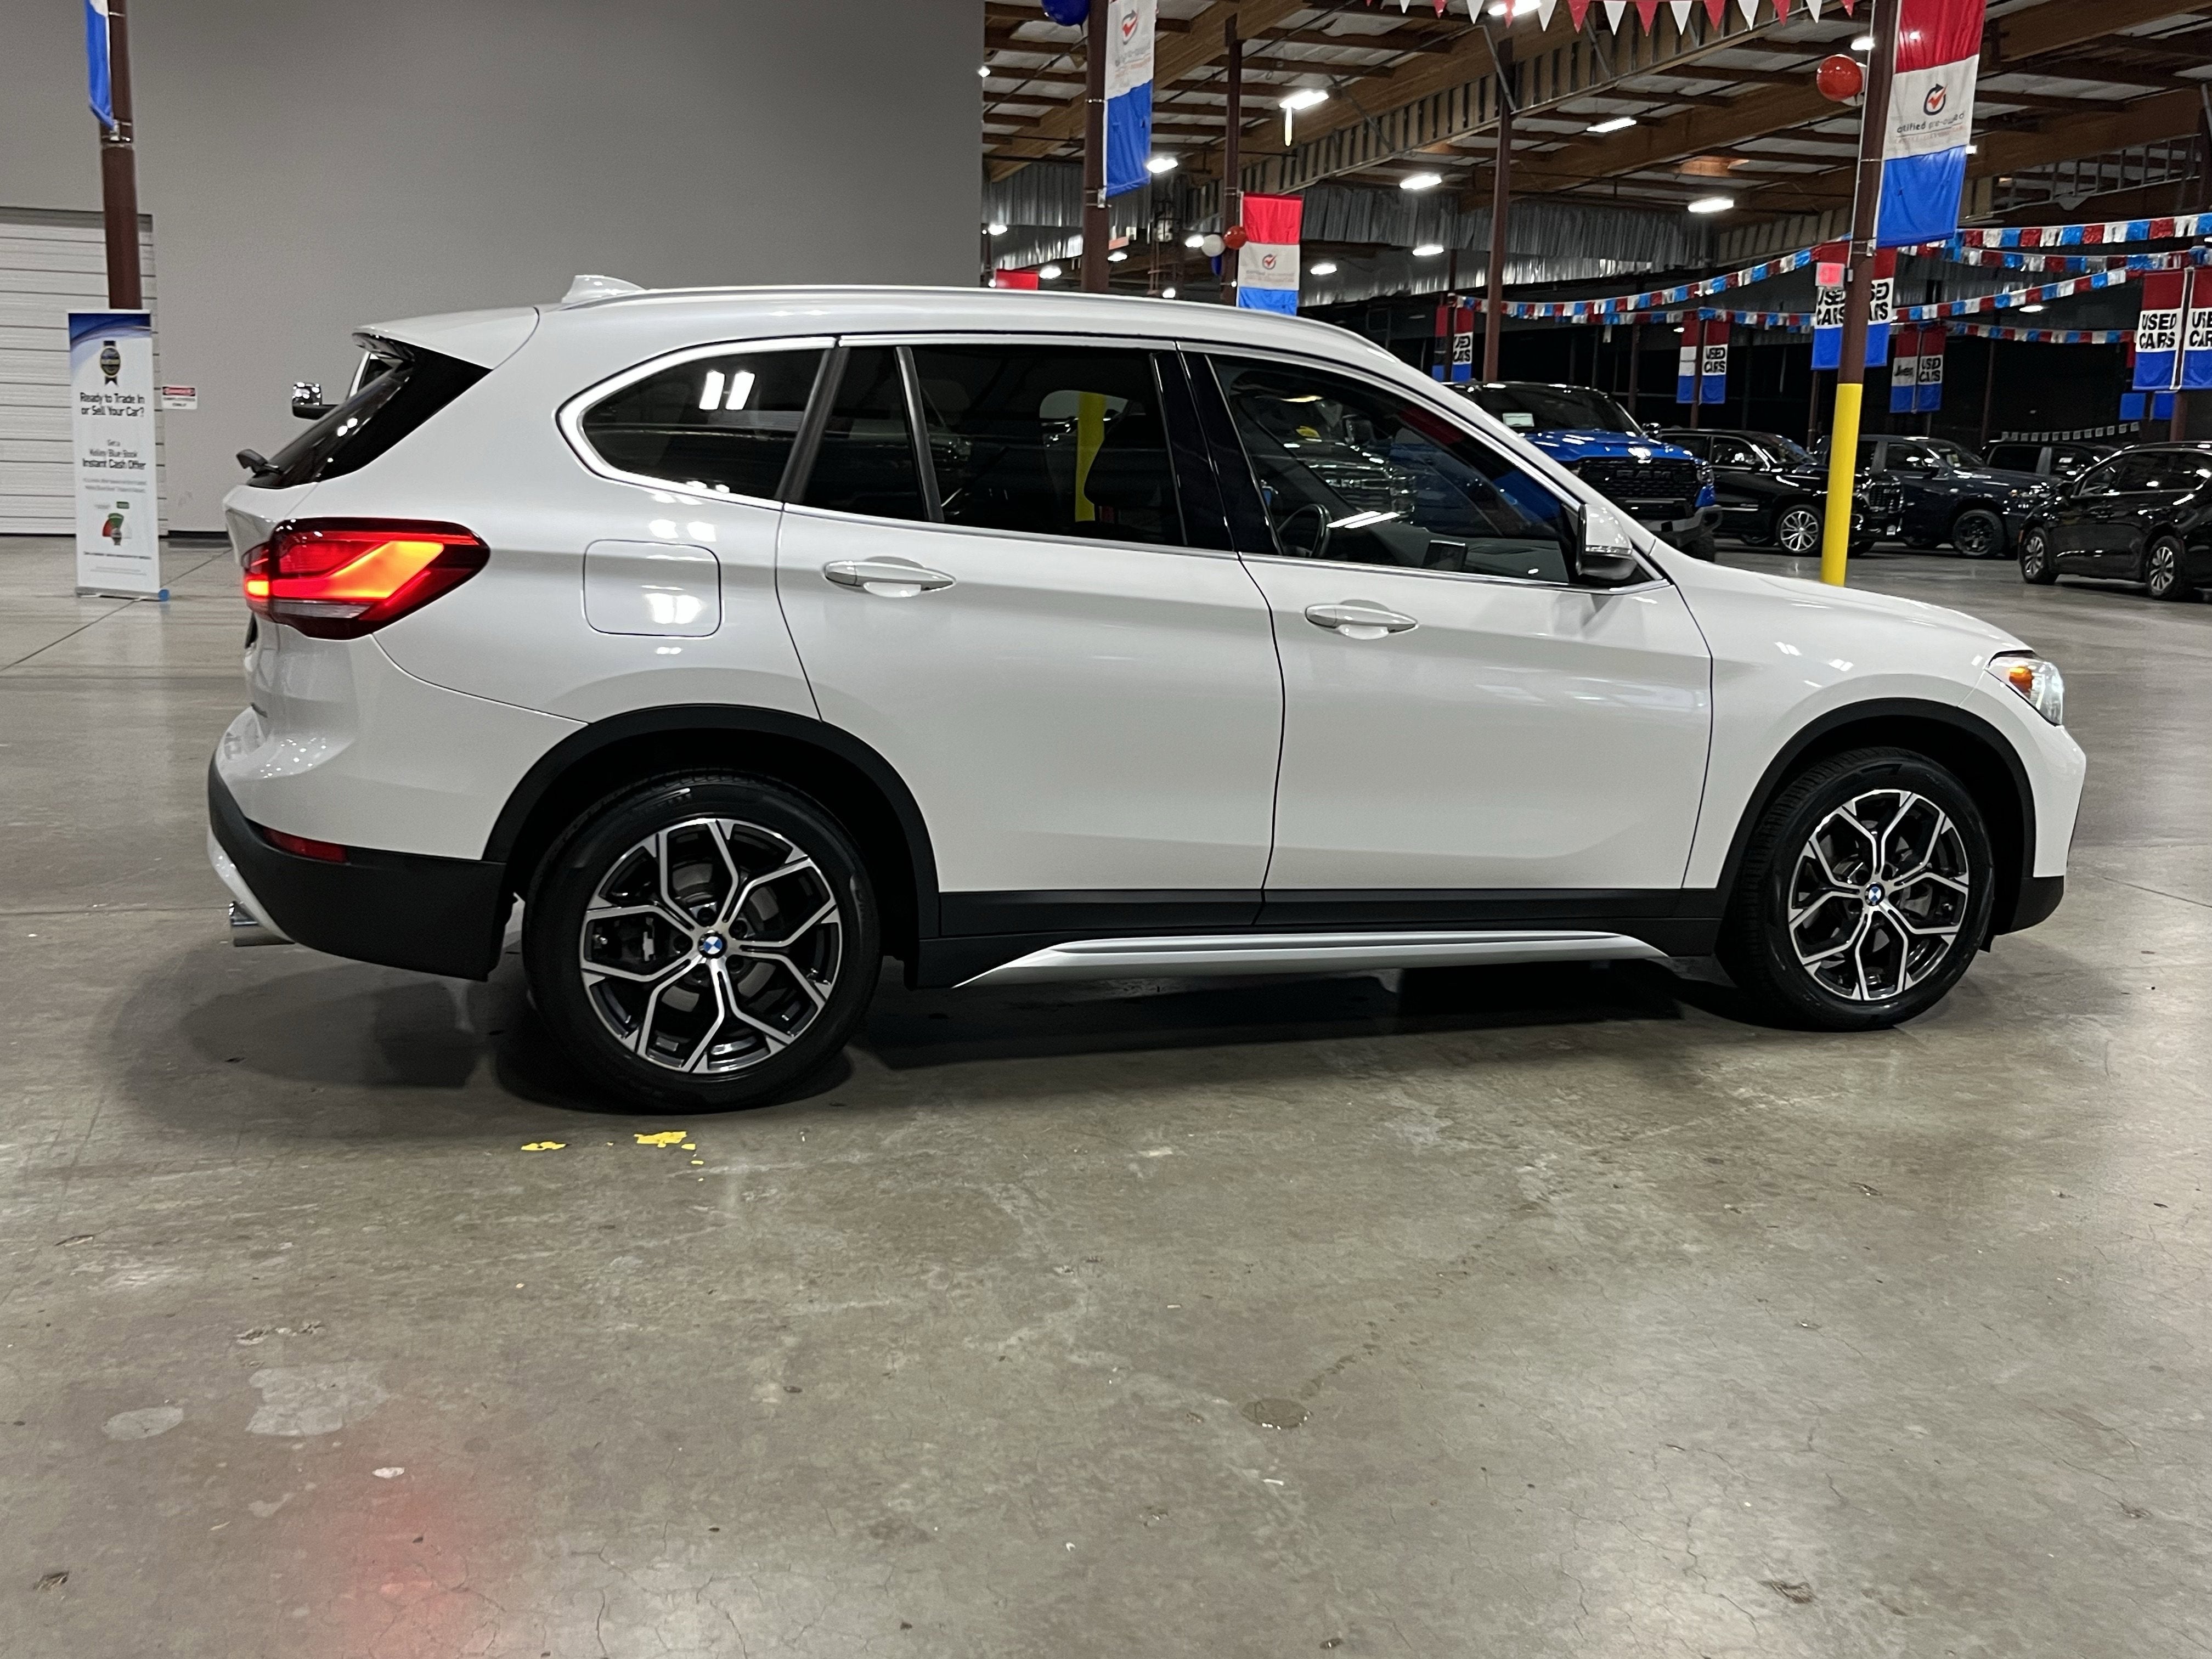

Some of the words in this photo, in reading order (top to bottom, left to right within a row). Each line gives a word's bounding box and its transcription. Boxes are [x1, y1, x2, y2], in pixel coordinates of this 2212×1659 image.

[1897, 121, 1926, 133] ctified
[2142, 313, 2177, 330] USED
[2192, 311, 2212, 329] USE
[2140, 331, 2175, 349] CARS
[2189, 330, 2212, 347] CAR
